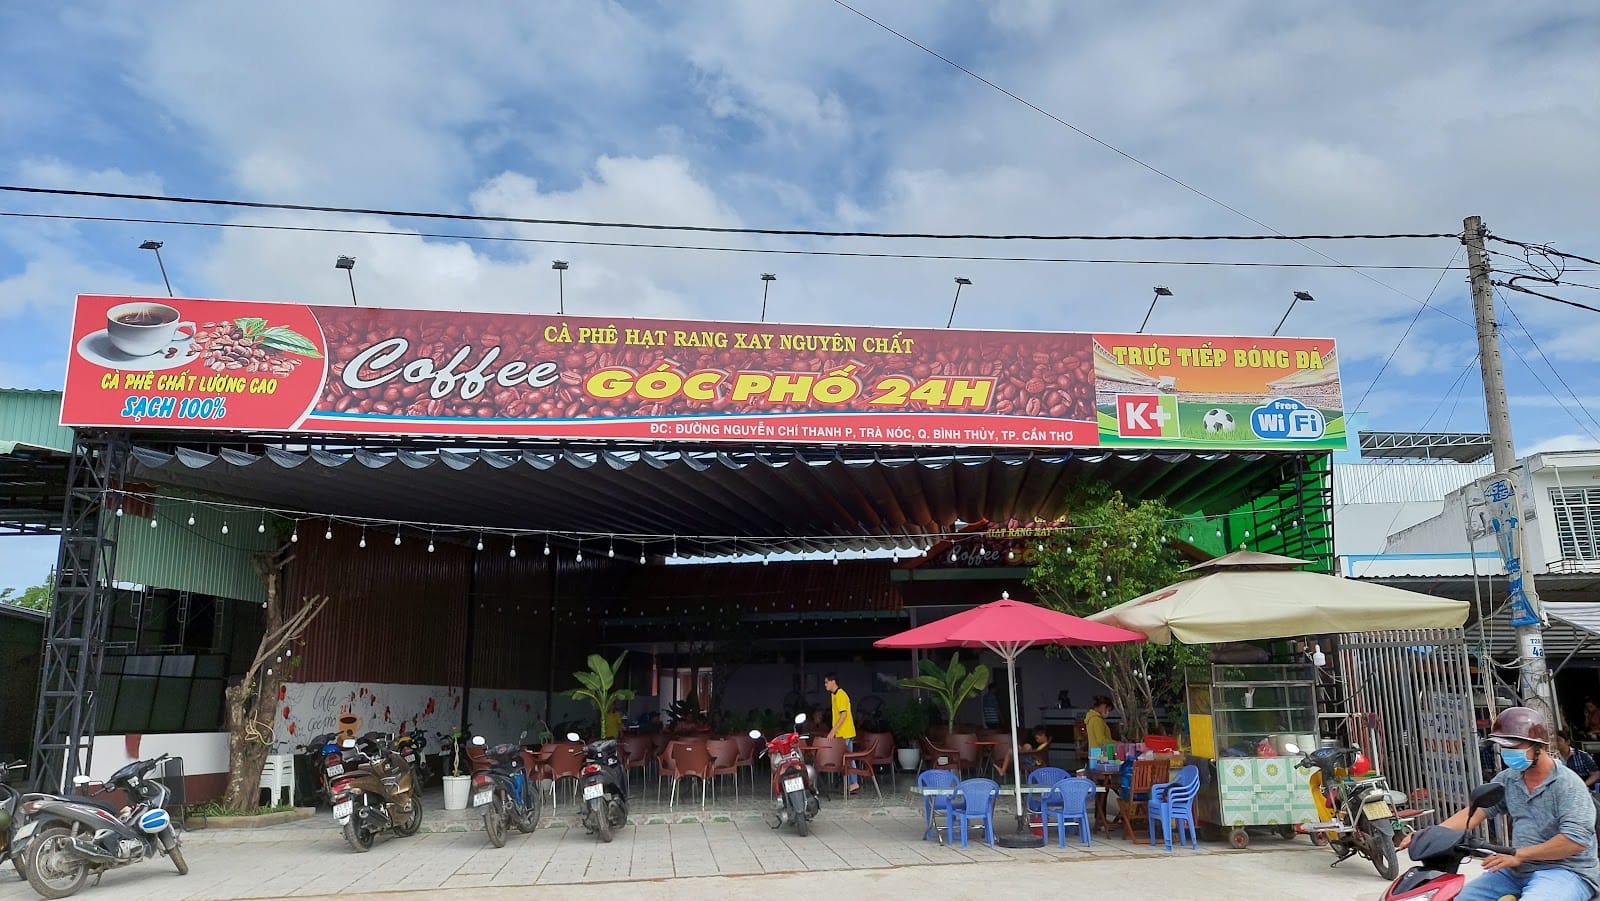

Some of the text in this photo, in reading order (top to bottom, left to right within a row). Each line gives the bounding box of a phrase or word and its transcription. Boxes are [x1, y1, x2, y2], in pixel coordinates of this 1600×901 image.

[544, 322, 914, 354] CÀ PHÊ HẠT RANG XAY NGUYÊN CHẤT
[342, 336, 559, 400] Coffee
[1112, 341, 1324, 371] TRỰC TIẾP BÓNG ĐÁ
[101, 368, 278, 397] CÀ PHÊ CHẤT LƯỢNG CAO
[585, 361, 992, 407] GÓC PHỐ 24H
[121, 396, 226, 422] SẠCH 100%
[1126, 402, 1171, 430] K+
[1275, 402, 1299, 411] Free
[650, 423, 673, 435] ĐC:
[675, 420, 720, 435] ĐƯỜNG
[723, 421, 775, 437] NGUYỄN
[777, 423, 799, 437] CHÍ
[801, 426, 842, 438] THANH
[859, 425, 883, 438] TRÀ
[886, 425, 915, 440] NÓC,
[917, 428, 930, 440] Q.
[933, 426, 961, 440] BÌNH
[1001, 429, 1020, 441] TP.
[1022, 426, 1046, 441] CẦN
[1049, 429, 1074, 442] THƠ
